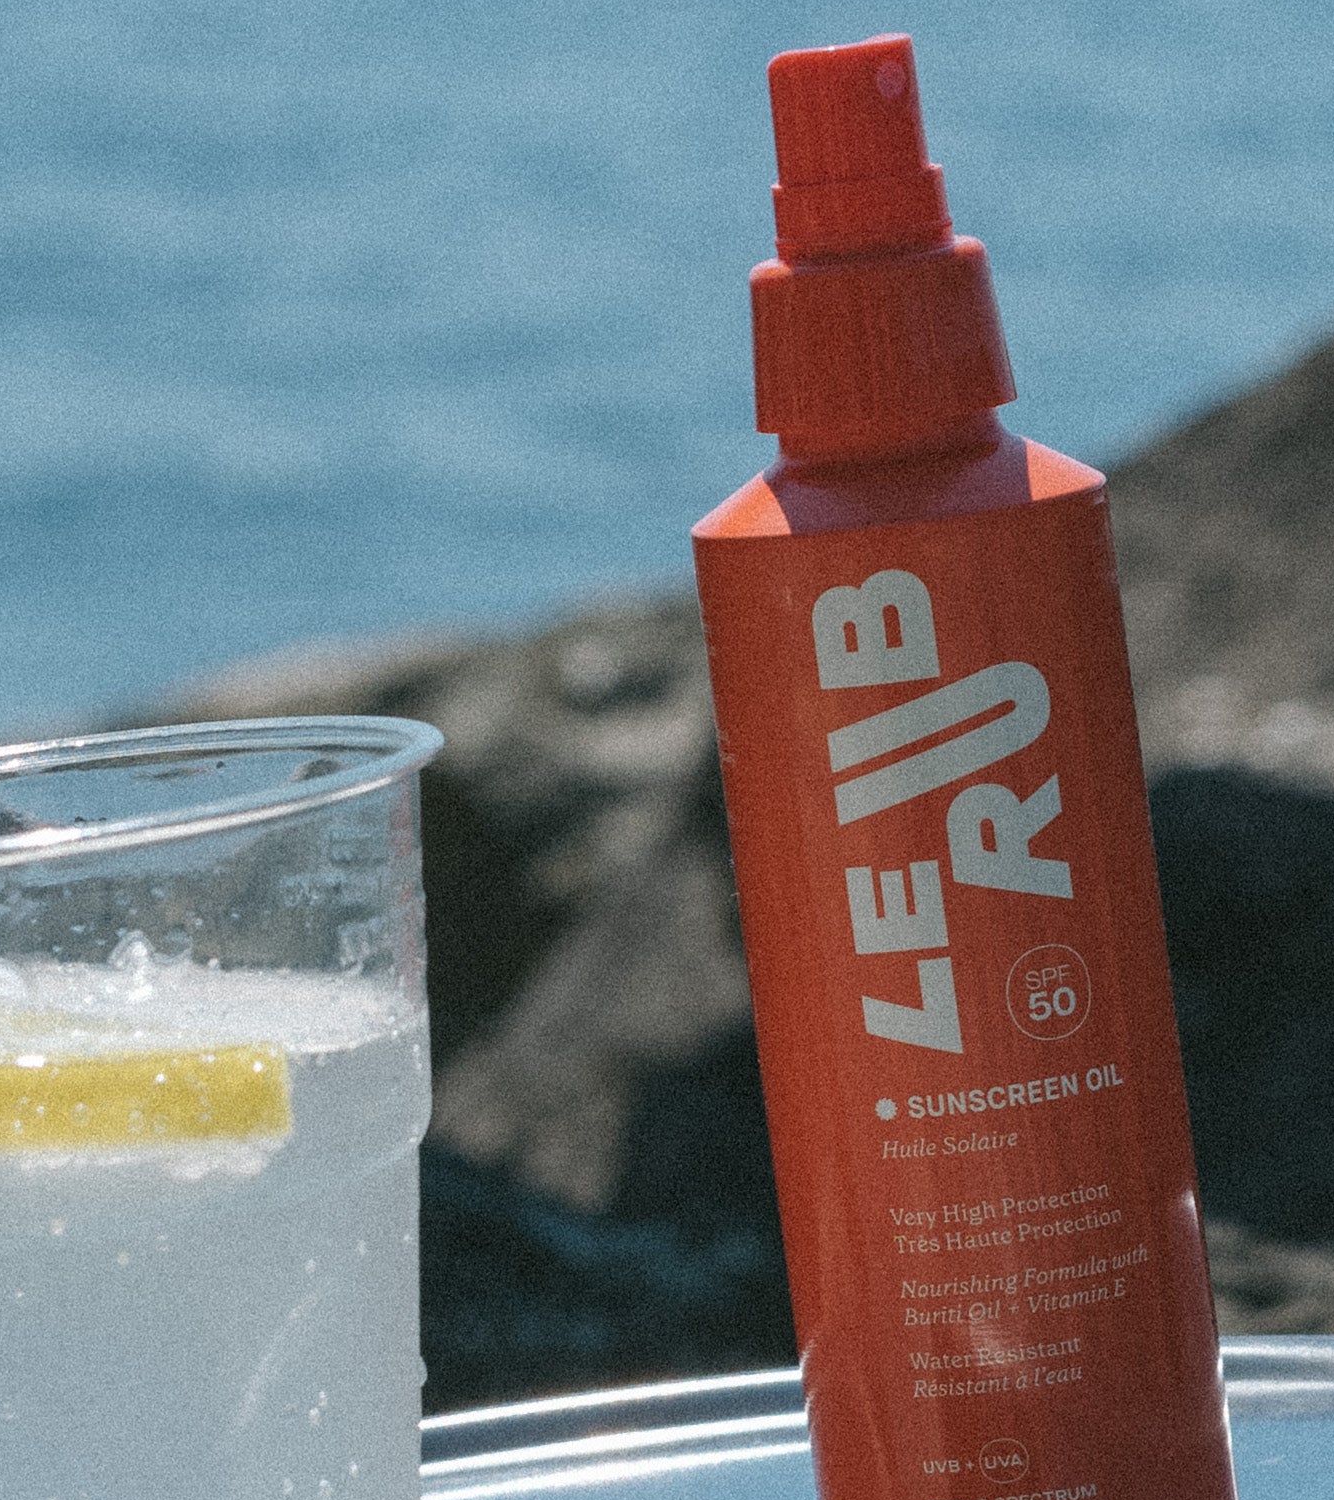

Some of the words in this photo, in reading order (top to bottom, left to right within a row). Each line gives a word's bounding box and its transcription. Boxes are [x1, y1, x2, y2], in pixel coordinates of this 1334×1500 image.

[845, 860, 964, 1054] LE
[1025, 964, 1071, 991] SPF
[1028, 986, 1077, 1021] 50
[908, 1073, 1079, 1119] SUNSCREEN
[1085, 1063, 1124, 1092] OIL
[882, 1138, 936, 1159] Huile
[942, 1131, 1018, 1155] Solaire
[889, 1208, 936, 1229] Very
[942, 1201, 996, 1225] High
[1001, 1184, 1109, 1216] Protection
[894, 1234, 940, 1254] Très
[945, 1231, 1012, 1251] Haute
[1018, 1209, 1121, 1241] Protection
[901, 1274, 1018, 1298] Nourishing
[1024, 1255, 1107, 1287] Formula
[1112, 1244, 1147, 1269] with
[904, 1304, 963, 1326] Buriti
[969, 1300, 1000, 1321] Oil
[1028, 1284, 1108, 1313] Vitamin
[1114, 1277, 1125, 1297] E
[909, 1352, 972, 1370] Water
[976, 1337, 1080, 1367] Resistant
[913, 1376, 1011, 1398] Résistant
[1016, 1371, 1027, 1389] à
[1034, 1365, 1083, 1386] l'eau
[923, 1459, 960, 1474] UVB
[984, 1453, 1023, 1470] UVA
